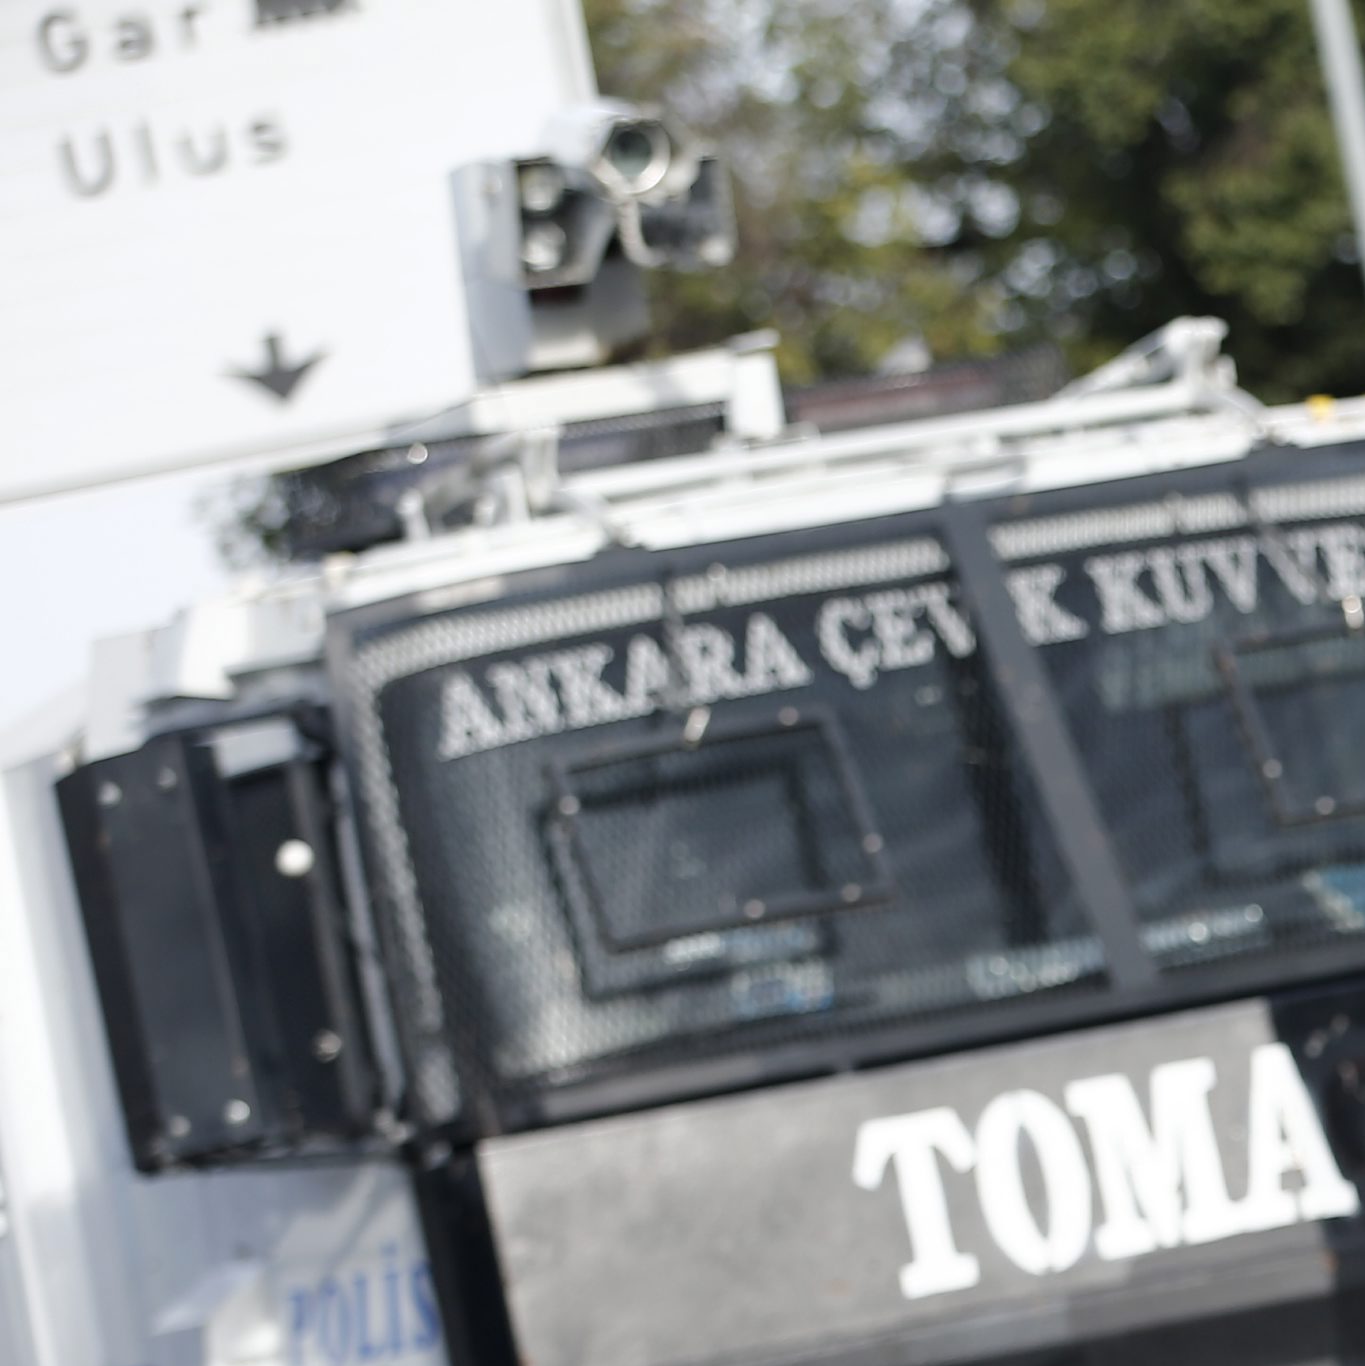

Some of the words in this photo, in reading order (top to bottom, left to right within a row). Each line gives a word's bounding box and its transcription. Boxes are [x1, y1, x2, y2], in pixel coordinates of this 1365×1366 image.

[36, 2, 206, 75] Gar
[56, 112, 288, 200] Ulus
[437, 613, 812, 762] ANKARA
[815, 562, 1087, 690] ÇEVK
[853, 1041, 1360, 1300] TOMA
